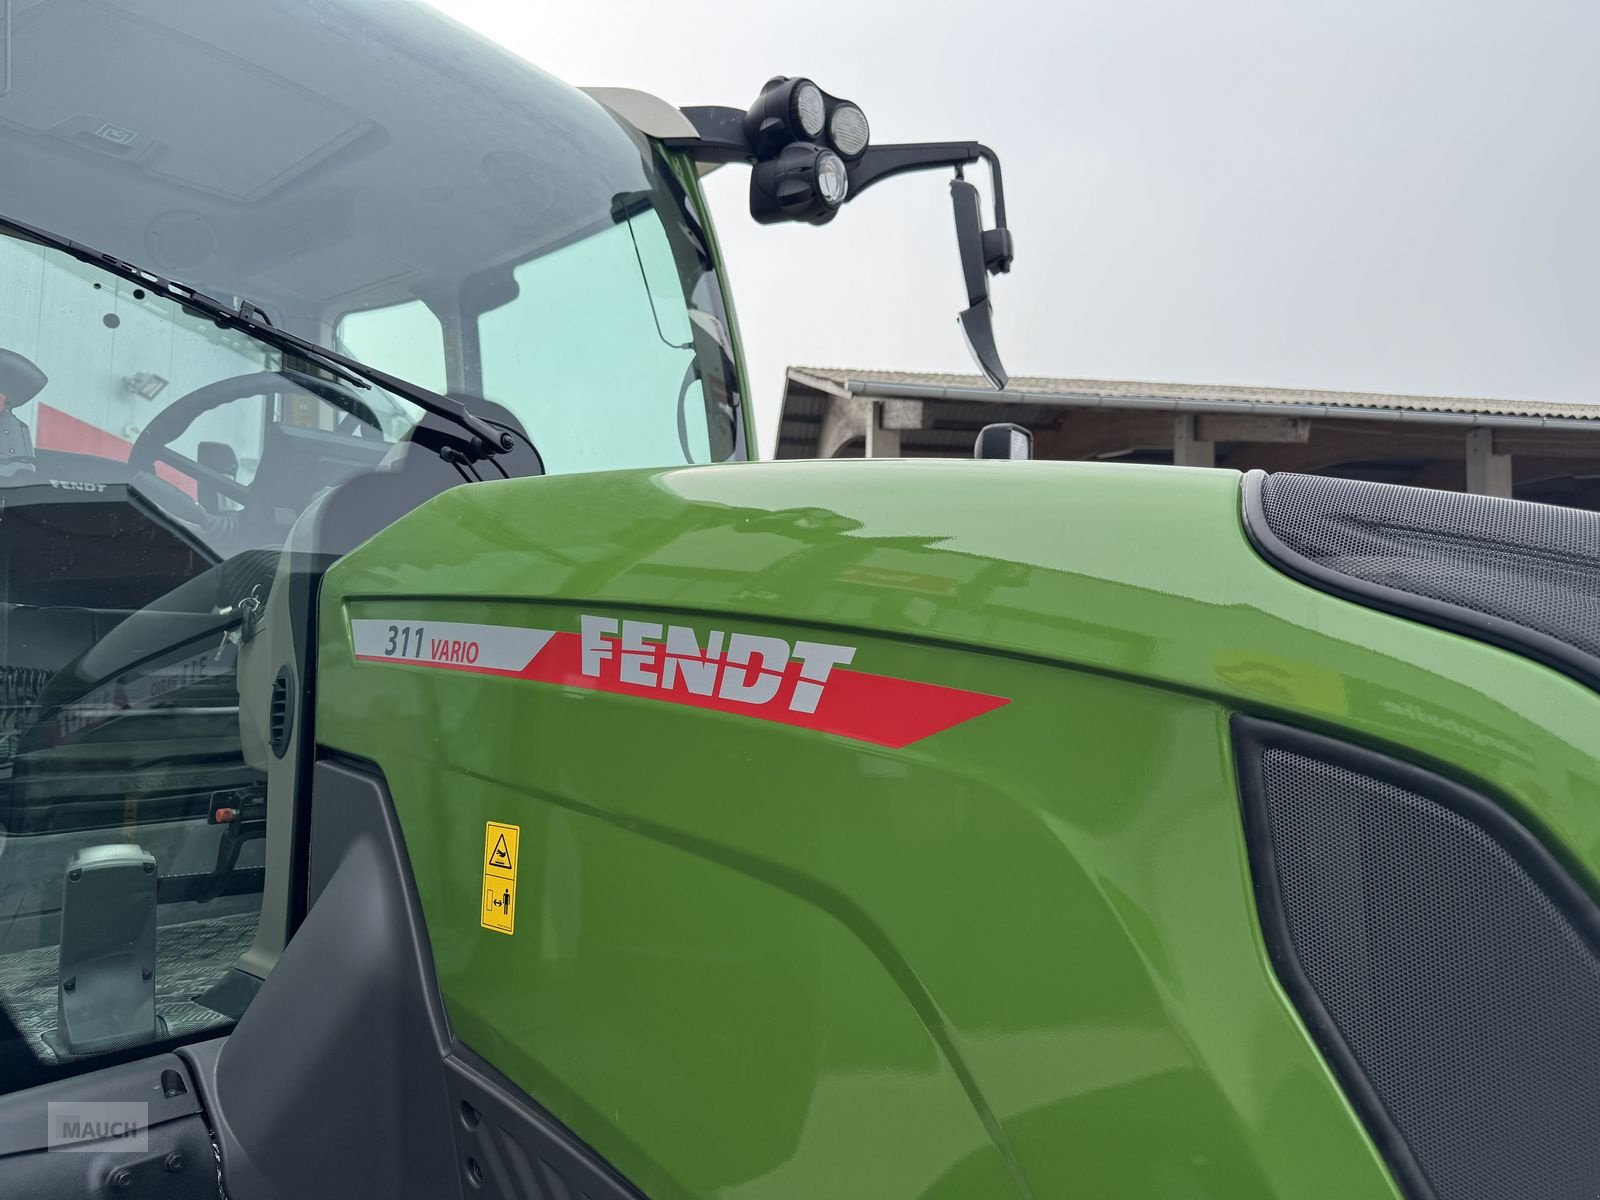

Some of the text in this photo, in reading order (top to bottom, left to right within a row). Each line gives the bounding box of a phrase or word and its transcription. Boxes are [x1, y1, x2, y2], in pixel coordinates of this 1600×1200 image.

[48, 479, 107, 493] FENDT
[384, 625, 479, 664] 311 VARIO
[581, 614, 857, 714] FENDT
